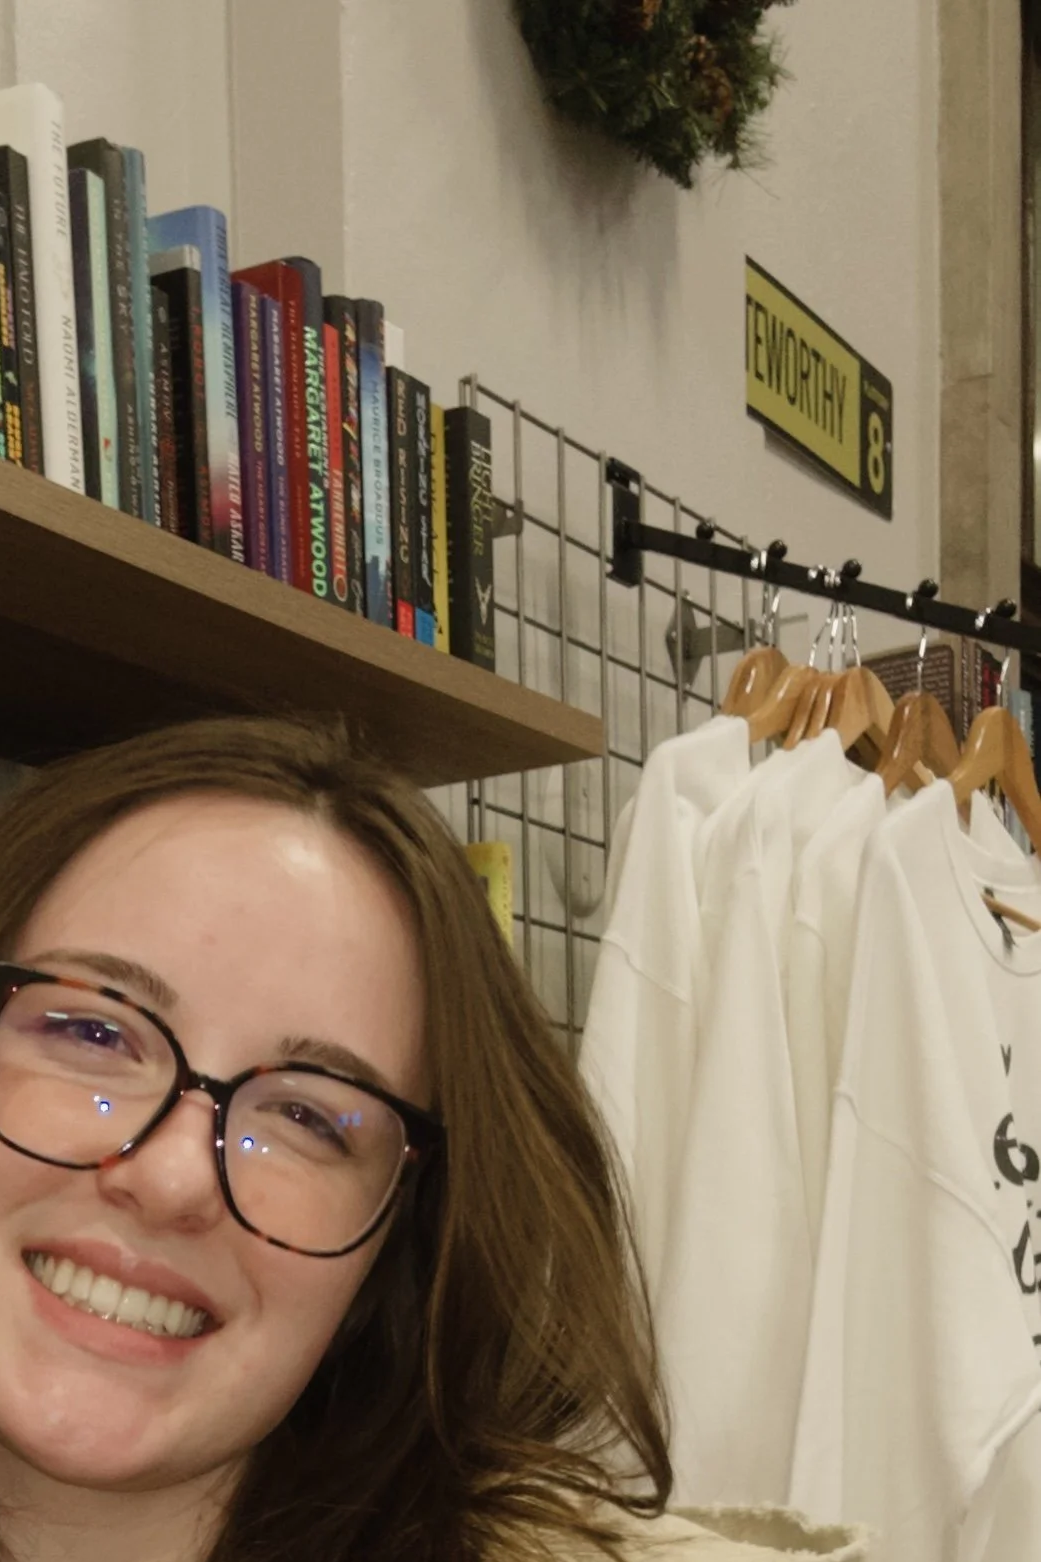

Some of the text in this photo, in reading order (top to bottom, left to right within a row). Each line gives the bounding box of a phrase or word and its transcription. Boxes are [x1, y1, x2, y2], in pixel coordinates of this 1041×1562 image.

[61, 315, 80, 490] NAOMI ALDERMAN
[303, 326, 327, 598] MARGARET ATWOOD
[371, 379, 384, 545] MAURICE BROADUS
